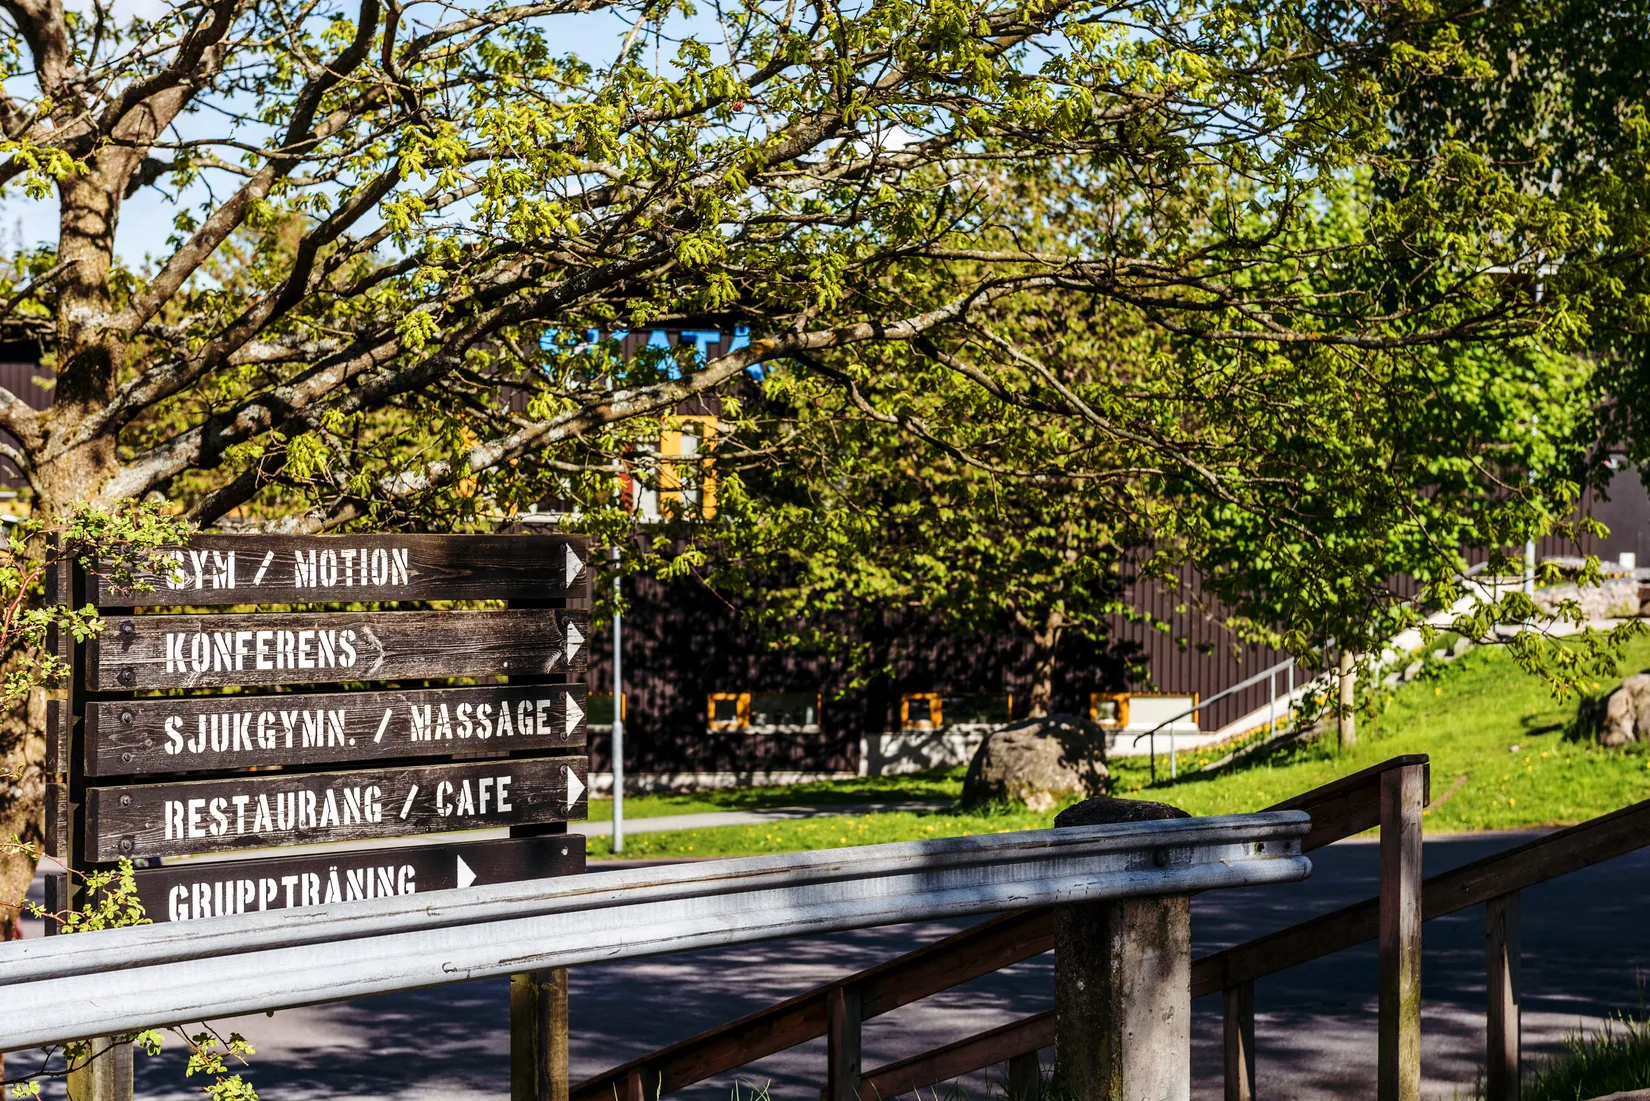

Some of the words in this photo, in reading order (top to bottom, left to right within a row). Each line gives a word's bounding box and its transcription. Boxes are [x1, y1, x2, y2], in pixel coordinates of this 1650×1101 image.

[166, 550, 236, 590] GYM
[295, 548, 409, 588] MOTION
[166, 629, 357, 673] KONFERENS
[164, 709, 356, 755] SJUKGYMN.
[411, 699, 551, 742] MASSAGE
[164, 785, 382, 840] RESTAURANG
[436, 775, 512, 817] CAFE
[168, 864, 417, 922] GRUPPTRÄNING
